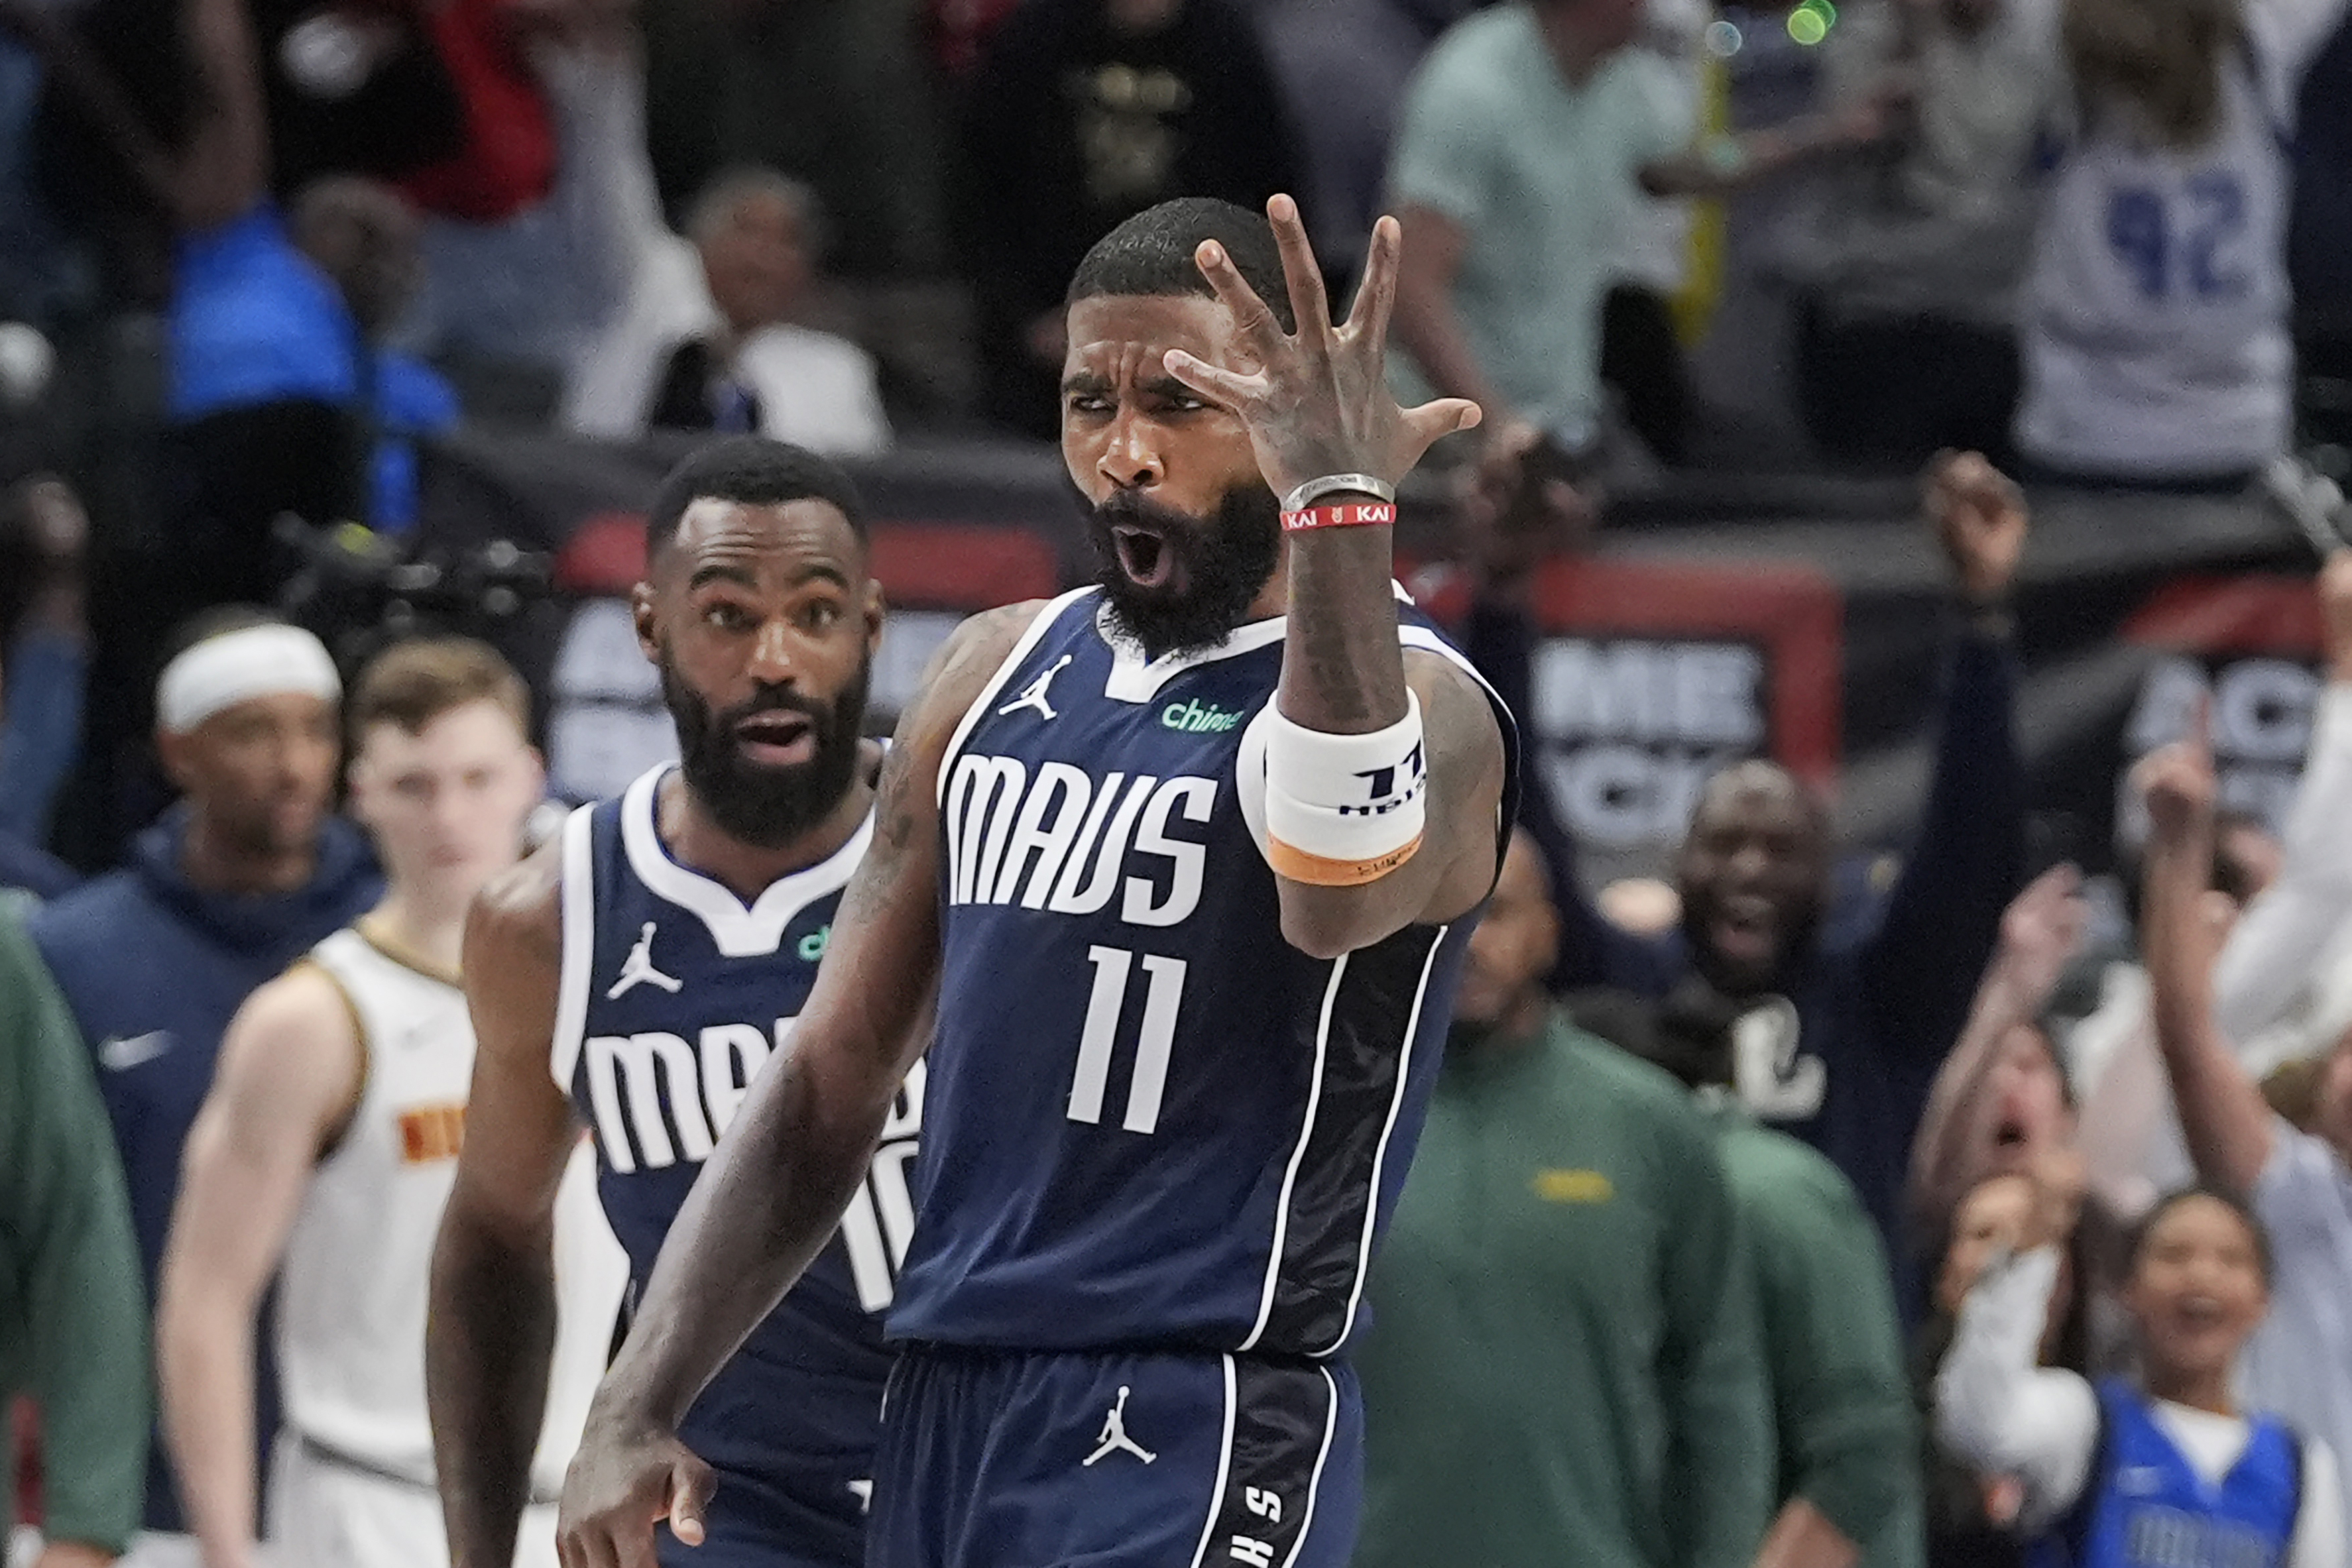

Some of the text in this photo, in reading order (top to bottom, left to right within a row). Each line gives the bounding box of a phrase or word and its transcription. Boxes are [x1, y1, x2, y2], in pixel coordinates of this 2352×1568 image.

[2105, 175, 2249, 301] 92
[1287, 506, 1389, 528] KAI KAI
[1162, 698, 1245, 732] chime
[1066, 944, 1187, 1135] 11
